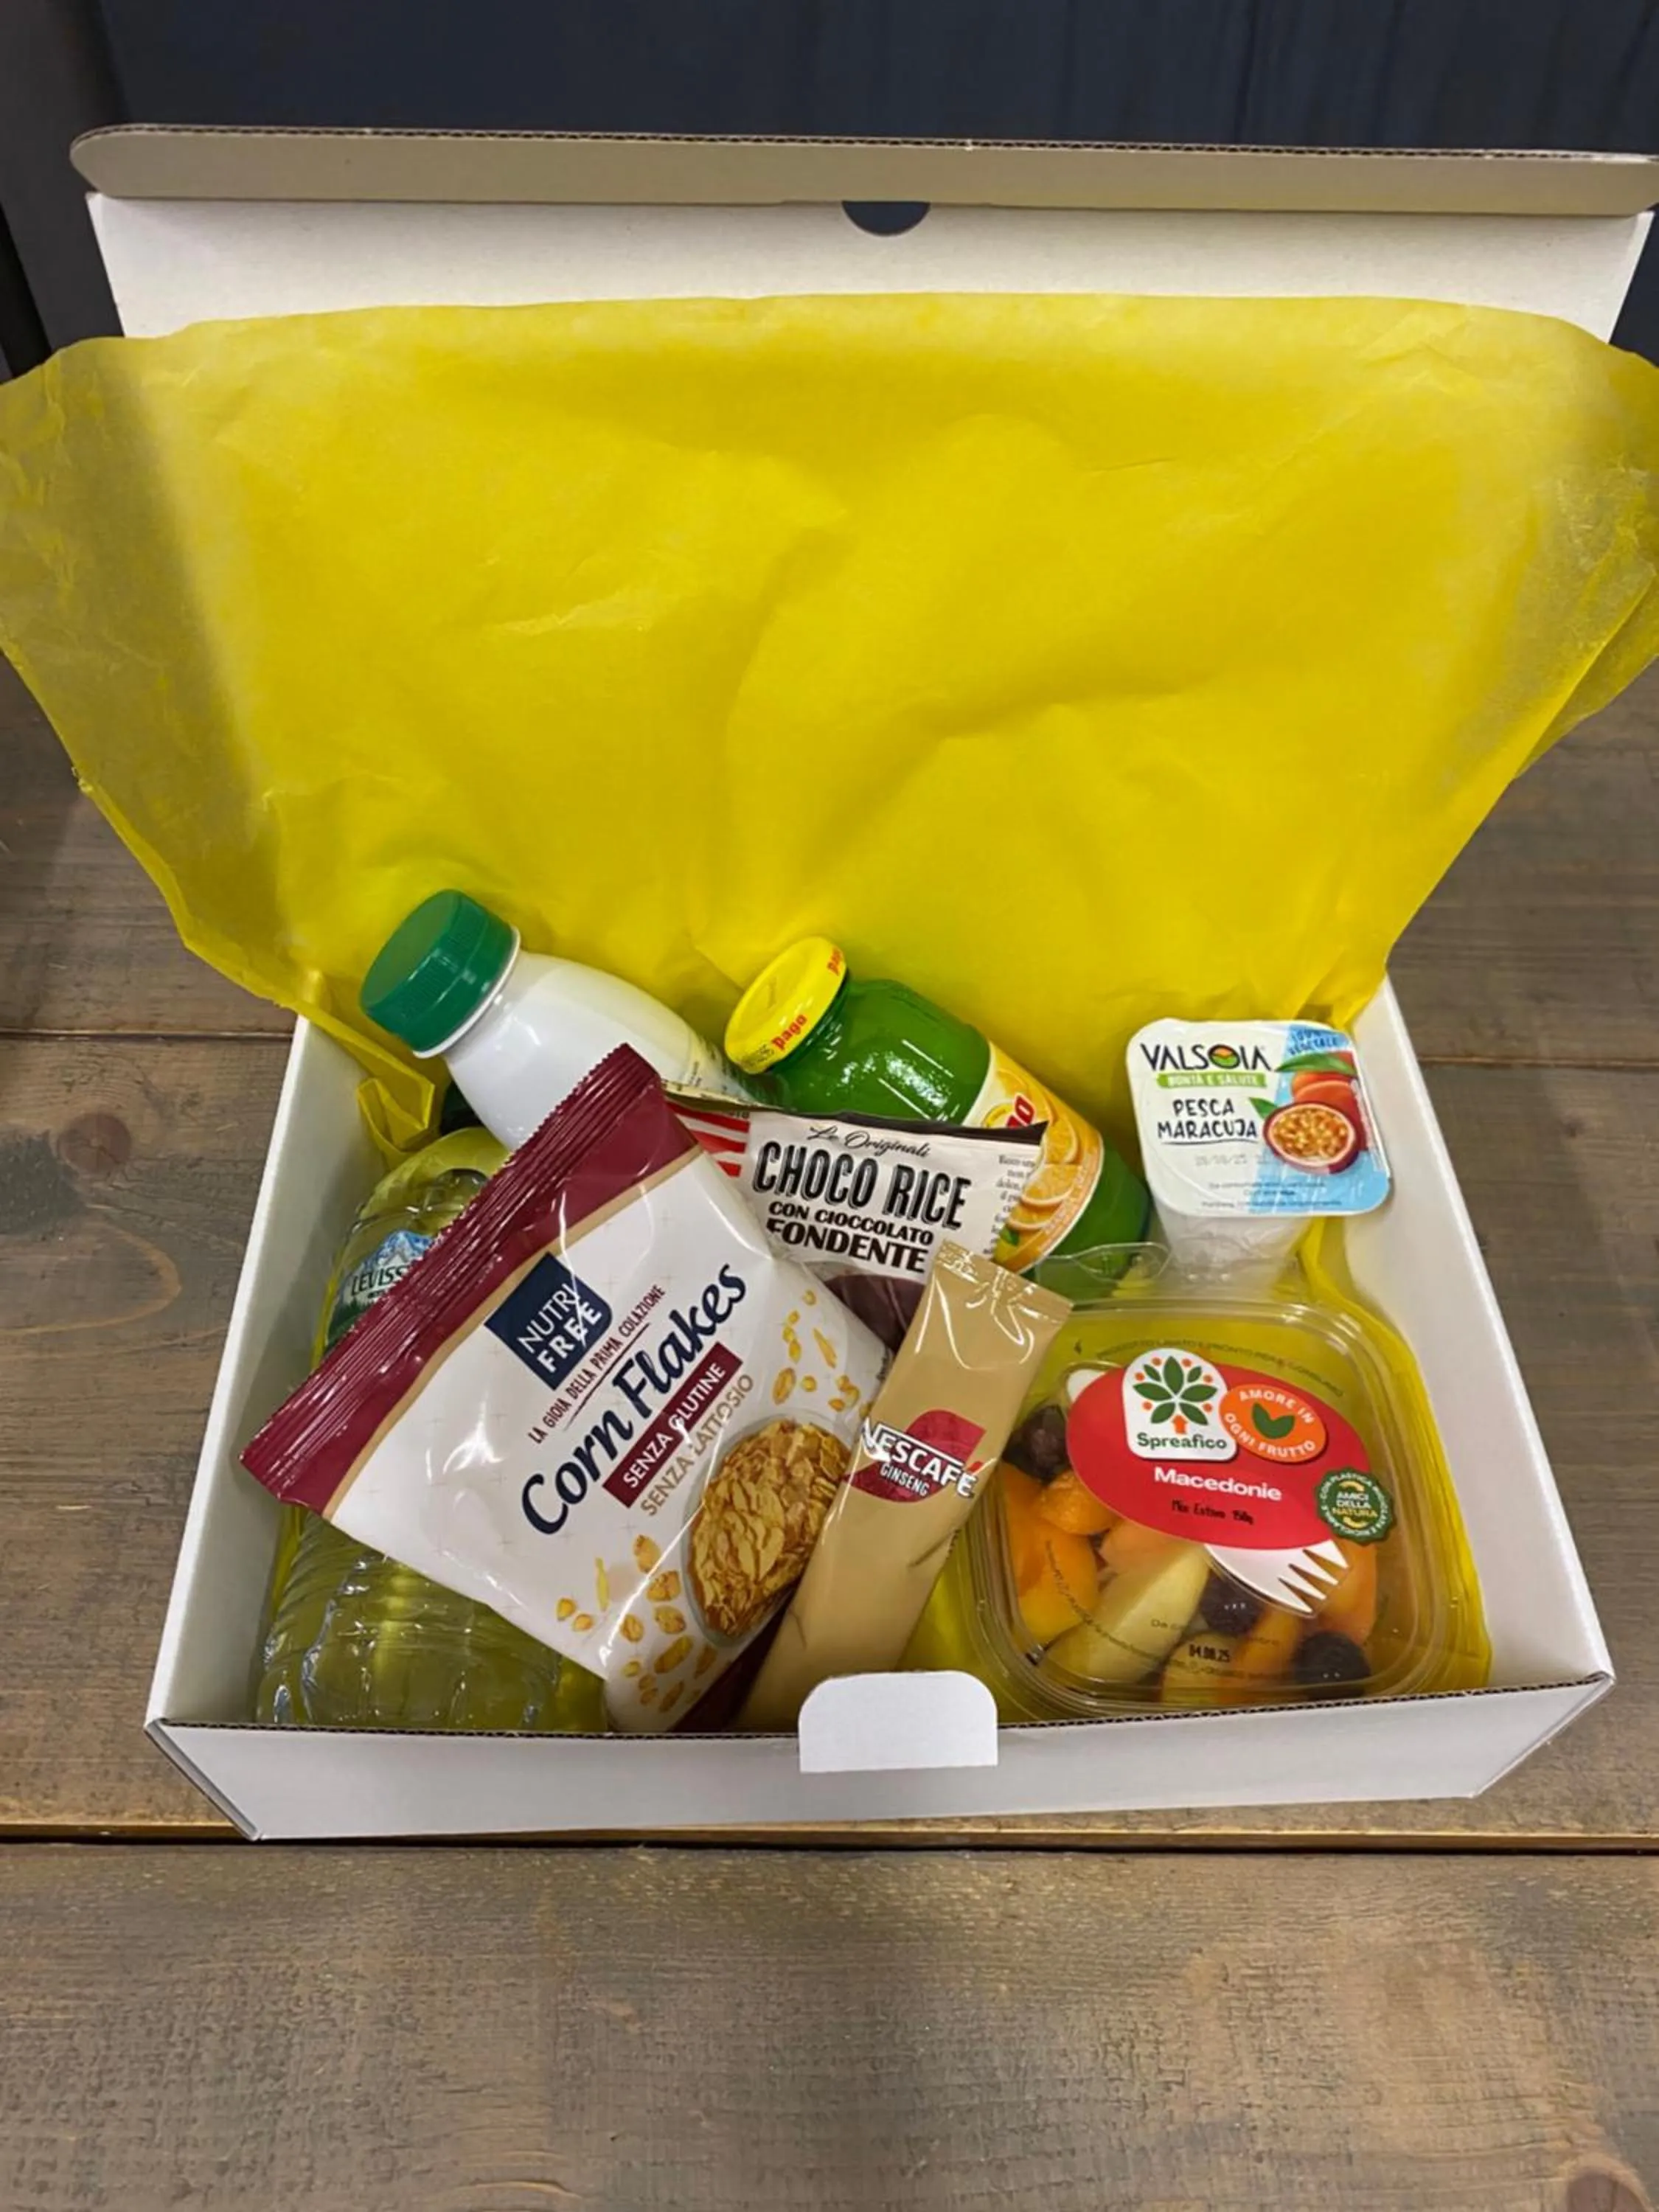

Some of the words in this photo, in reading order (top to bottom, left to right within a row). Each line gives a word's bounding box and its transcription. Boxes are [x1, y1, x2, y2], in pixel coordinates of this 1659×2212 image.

[771, 1014, 808, 1051] pago
[1140, 1043, 1273, 1071] VALSOIA
[1158, 1119, 1258, 1139] MARACUJA
[1172, 1098, 1235, 1117] PESCA
[807, 1125, 839, 1141] Le
[844, 1130, 931, 1158] Originali
[752, 1141, 879, 1210] CHOCO
[882, 1164, 973, 1231] RICE
[765, 1217, 929, 1274] FONDENTE
[768, 1201, 810, 1219] CON
[814, 1208, 934, 1246] CIOCCOLATO
[518, 1284, 580, 1354] NUTRI
[537, 1300, 602, 1373] FREE
[529, 1426, 546, 1445] LA
[544, 1397, 572, 1430] GIOIA
[568, 1368, 594, 1401] DELLA
[591, 1337, 622, 1371] PRIMA
[619, 1284, 667, 1338] COLAZIONE
[521, 1409, 633, 1535] Corn
[611, 1263, 747, 1419] Flakes
[1239, 1389, 1296, 1409] AMORE
[1298, 1407, 1315, 1424] IN
[622, 1433, 674, 1489] SENZA
[667, 1362, 726, 1434] GLUTINE
[640, 1455, 695, 1517] SENZA
[691, 1374, 754, 1456] LATTOSIO
[1137, 1432, 1228, 1450] Spreafico
[1224, 1413, 1255, 1446] OGNI
[1258, 1440, 1315, 1458] FRUTTO
[880, 1462, 931, 1497] GINSENG
[1154, 1467, 1282, 1500] Macedonie
